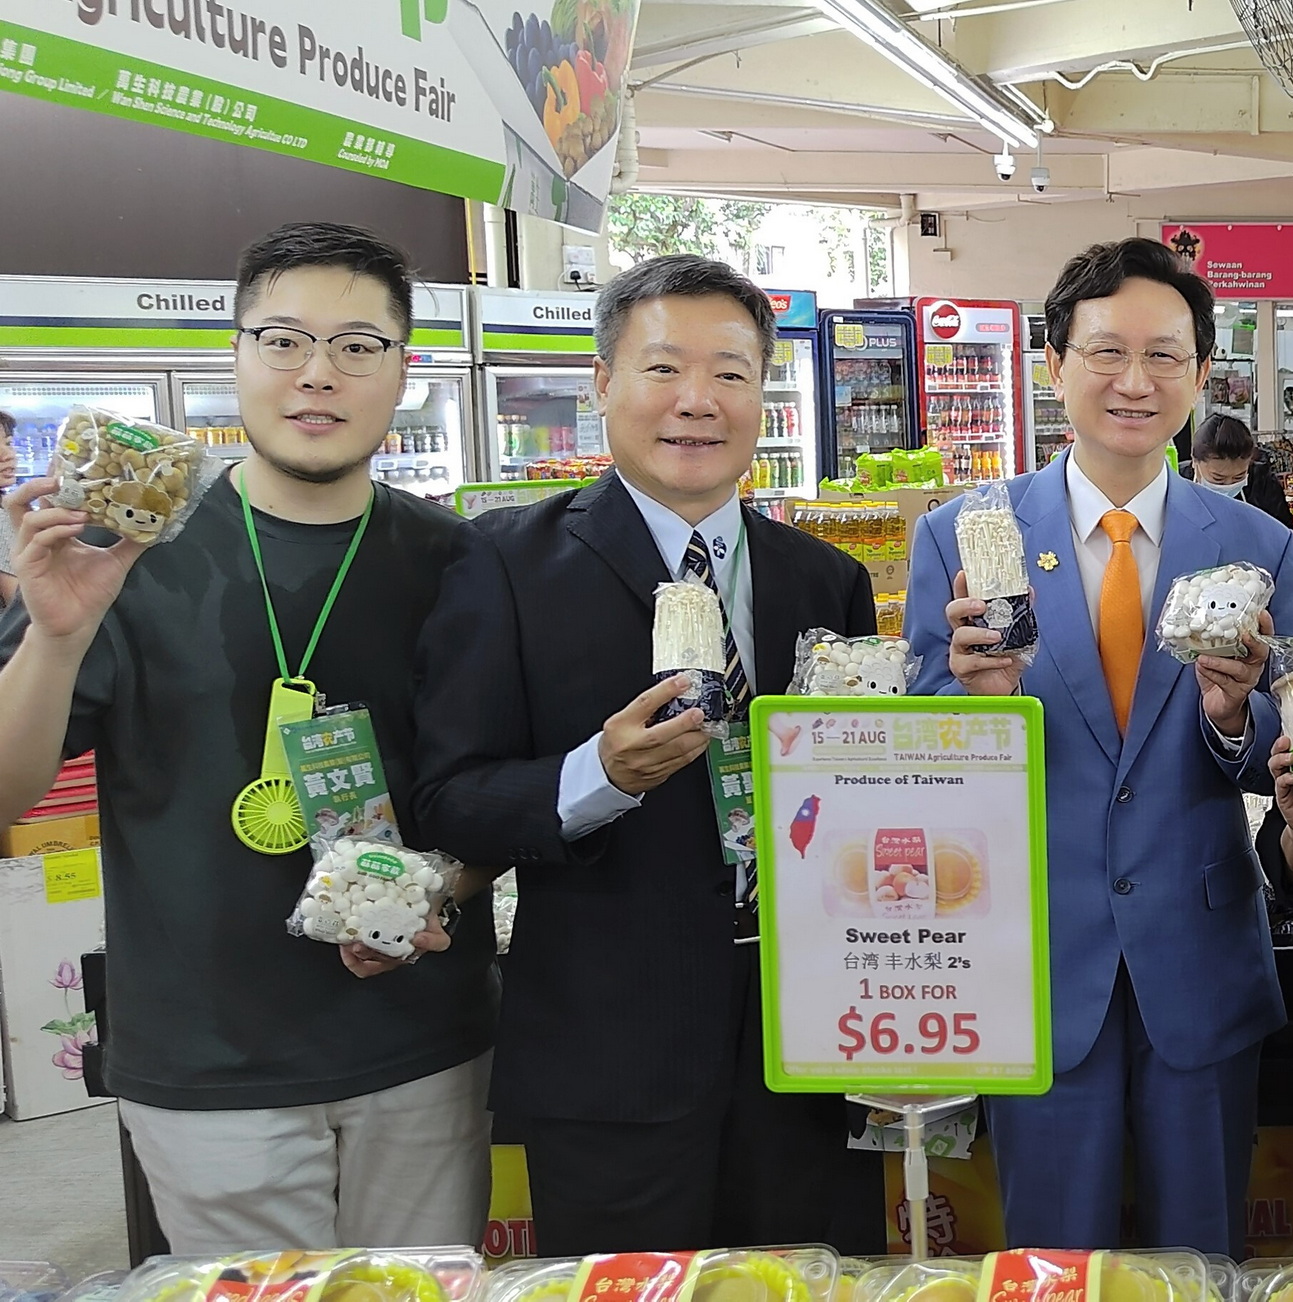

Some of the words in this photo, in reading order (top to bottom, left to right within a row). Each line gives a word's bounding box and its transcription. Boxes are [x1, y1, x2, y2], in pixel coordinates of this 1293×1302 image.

[299, 25, 407, 107] Produce
[414, 68, 457, 123] Fair
[24, 69, 57, 92] Group
[57, 77, 95, 98] Limited
[1207, 261, 1243, 269] Sewaan
[1207, 270, 1272, 280] Barang-barang
[136, 293, 226, 312] Chilled
[532, 306, 592, 321] Chilled
[868, 337, 897, 348] PLUS
[858, 731, 886, 744] AUG
[892, 717, 1012, 751] 台湾农产节
[894, 753, 926, 761] TAIWAN
[927, 753, 969, 762] Agriculture
[970, 753, 998, 761] Produce
[999, 753, 1012, 762] Fair
[834, 774, 892, 785] Produce
[895, 774, 910, 785] of
[913, 774, 964, 785] Taiwan
[846, 928, 911, 944] Sweet
[918, 928, 967, 944] Pear
[843, 952, 879, 970] 台湾
[885, 952, 942, 970] 丰水梨
[947, 955, 971, 969] 2's
[859, 978, 873, 1000] 1
[879, 985, 915, 1000] BOX
[921, 985, 957, 1000] FOR
[837, 1005, 981, 1061] $6.95
